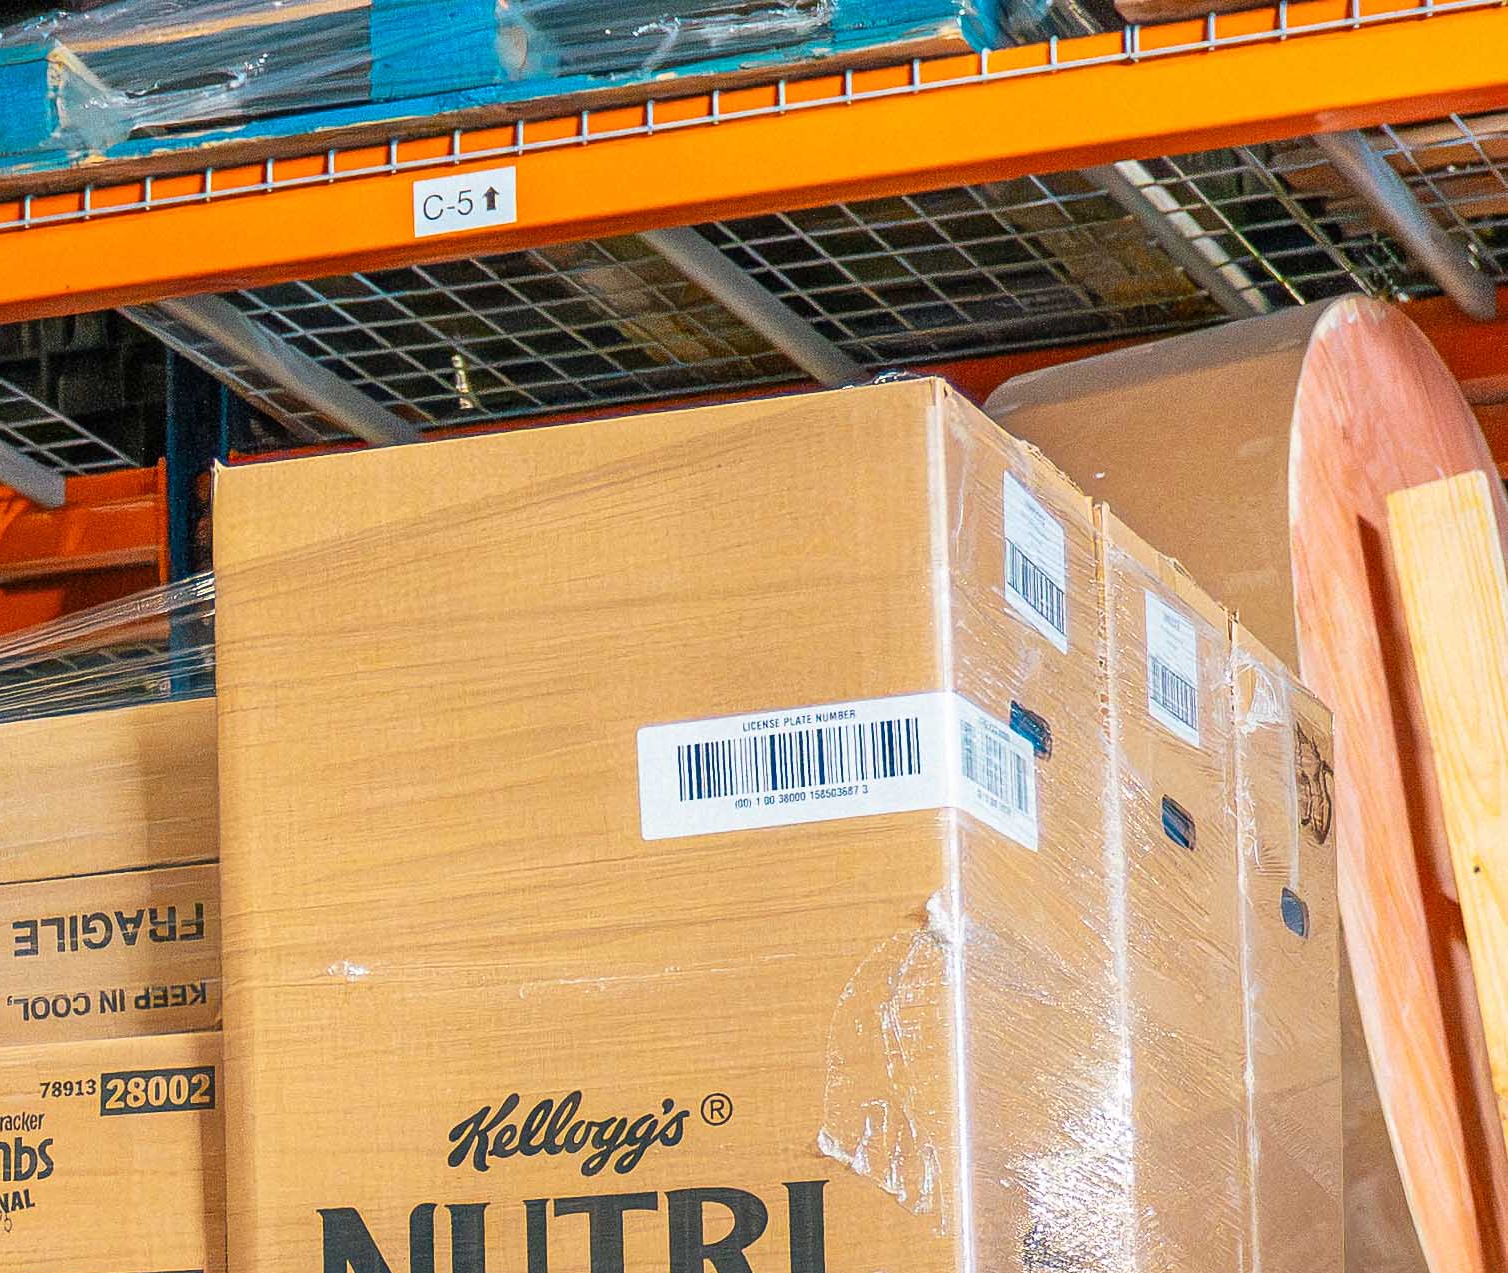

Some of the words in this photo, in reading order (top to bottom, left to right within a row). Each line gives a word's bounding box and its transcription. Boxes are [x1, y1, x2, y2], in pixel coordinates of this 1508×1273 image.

[421, 190, 475, 221] C-5
[742, 718, 780, 732] LICENSE
[783, 715, 812, 728] PLATE
[815, 709, 856, 723] NUMBER
[778, 792, 806, 804] 38000
[862, 784, 869, 794] 3
[12, 903, 205, 957] FRAGILE
[6, 992, 91, 1021] COOL,
[98, 989, 126, 1012] IN
[133, 983, 208, 1010] KEEP
[39, 1079, 97, 1099] 78913
[104, 1073, 211, 1110] 28002
[448, 1090, 690, 1176] Kellogg's
